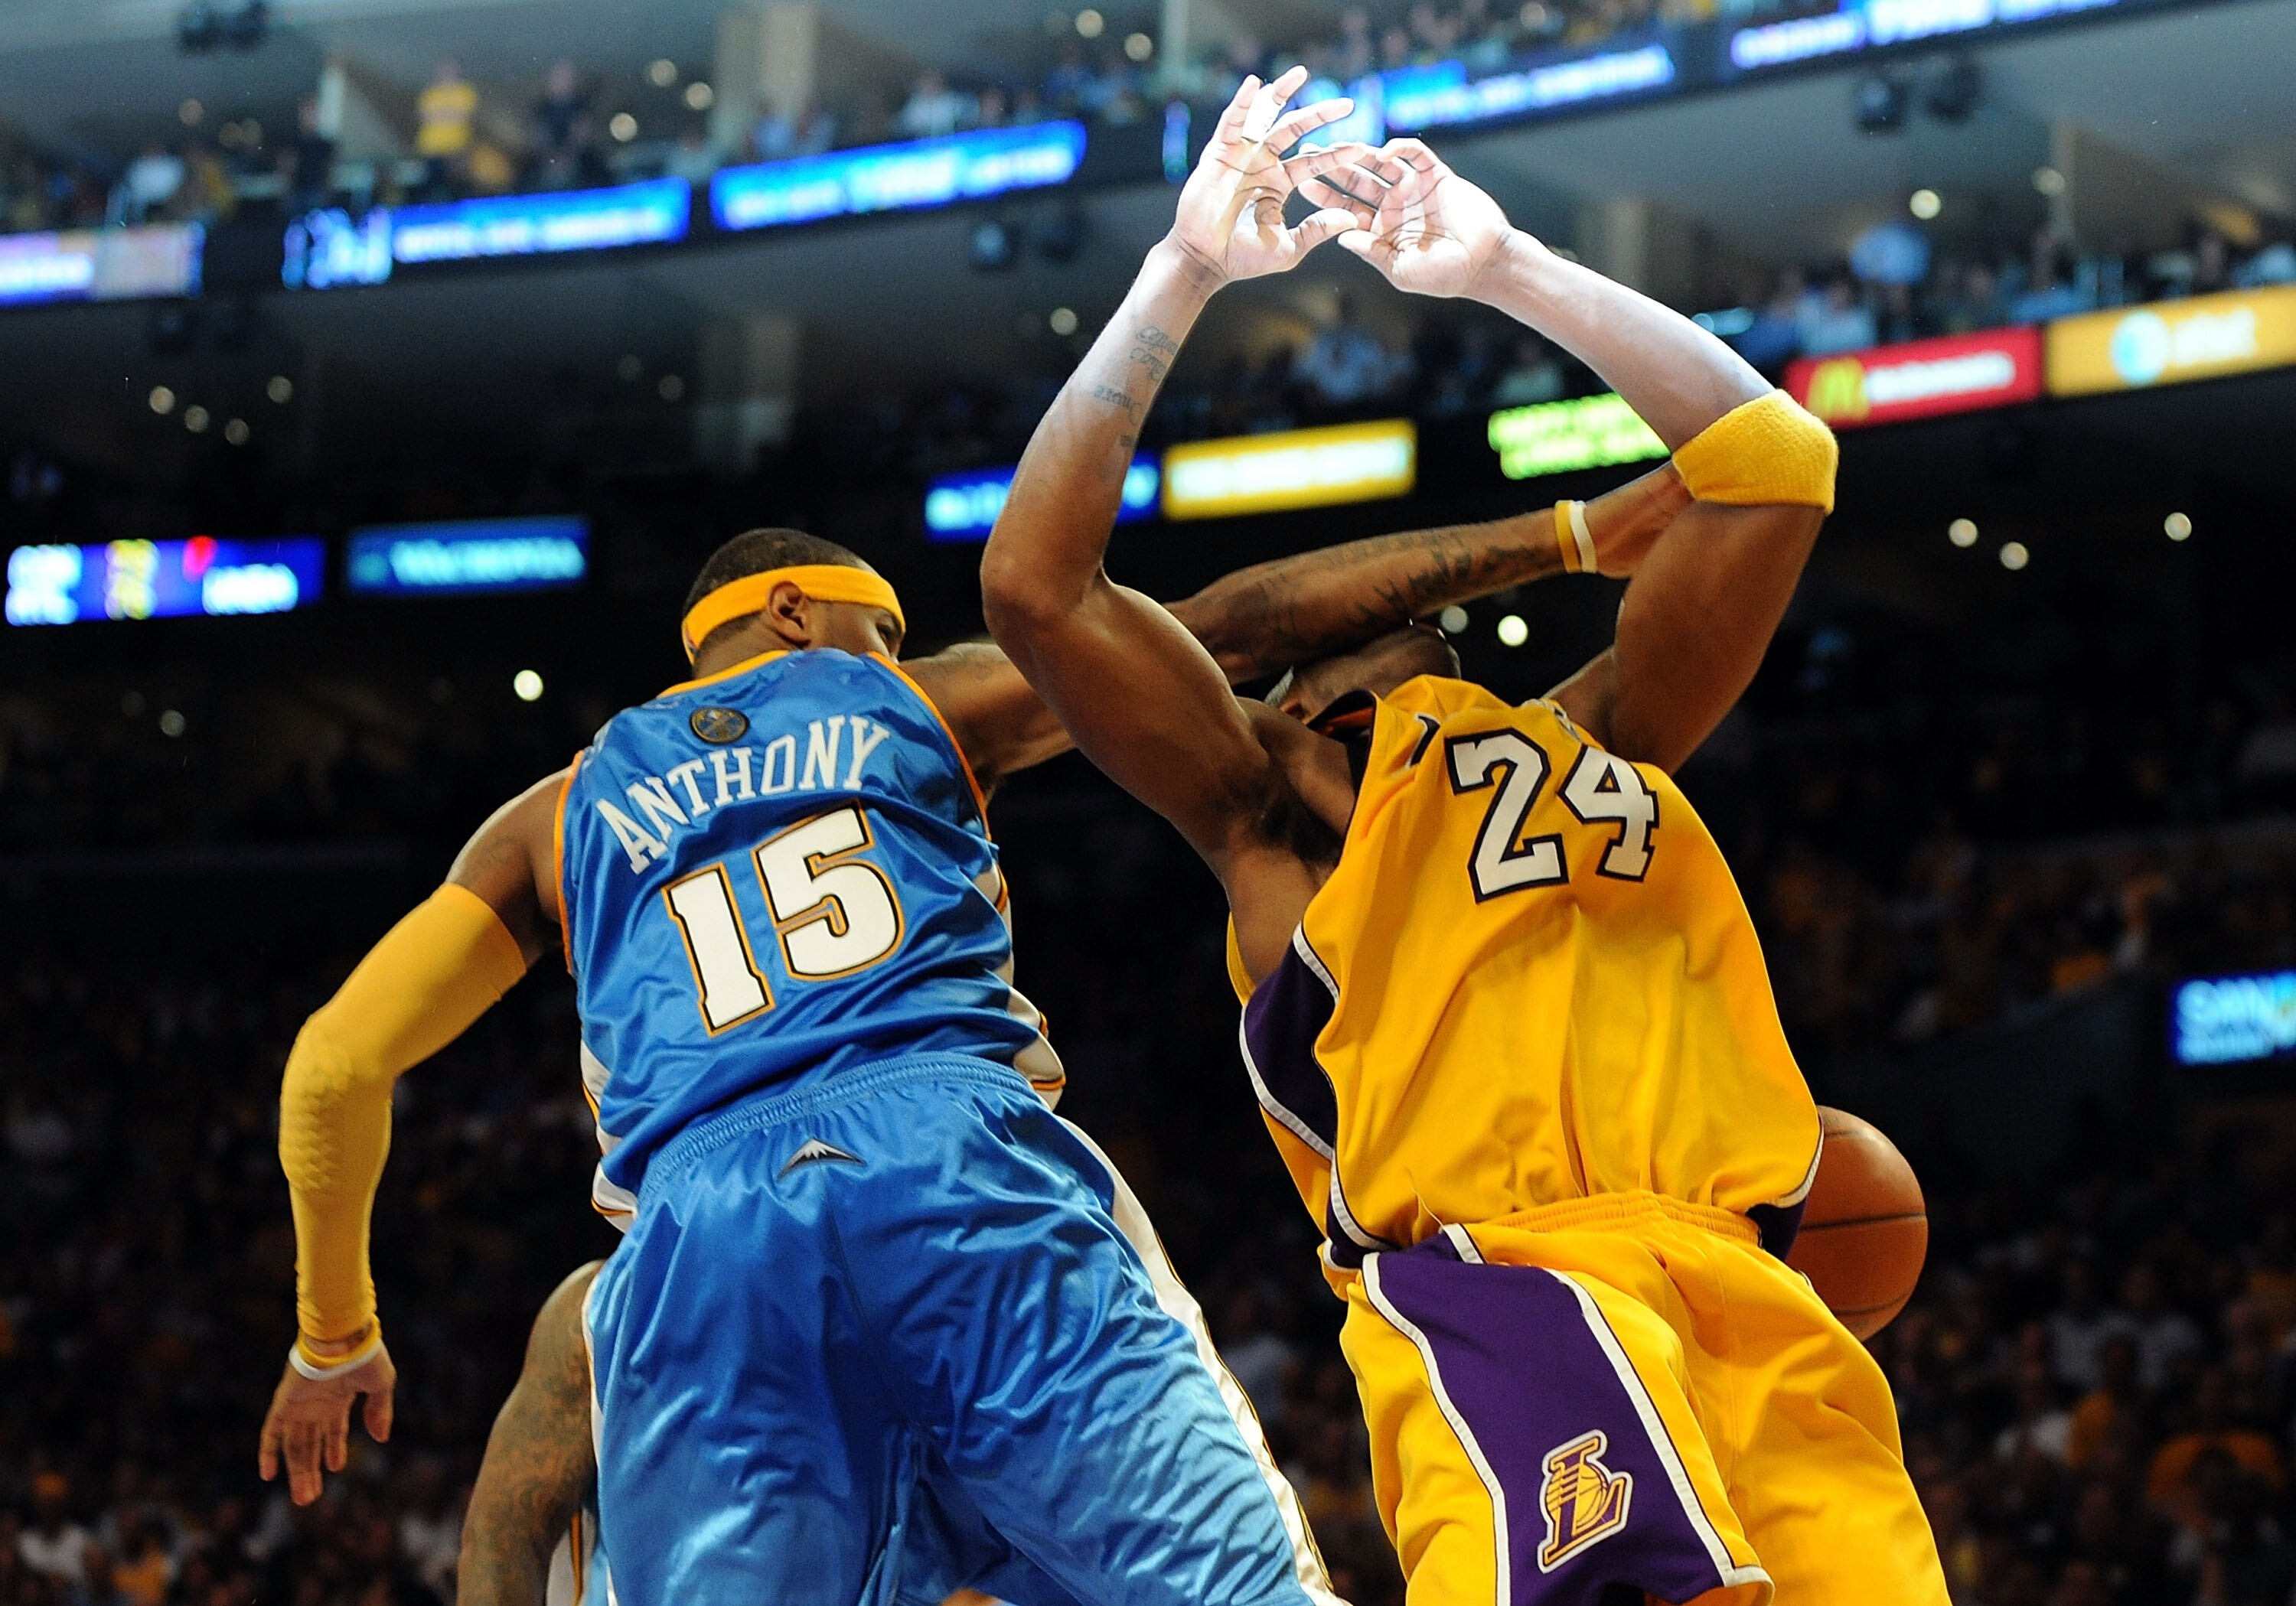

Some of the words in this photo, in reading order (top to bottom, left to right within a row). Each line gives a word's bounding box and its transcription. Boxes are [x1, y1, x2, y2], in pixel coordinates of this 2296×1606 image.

[597, 715, 891, 875] ANTHONY
[1444, 728, 1660, 904] 24
[661, 800, 905, 1039] 15
